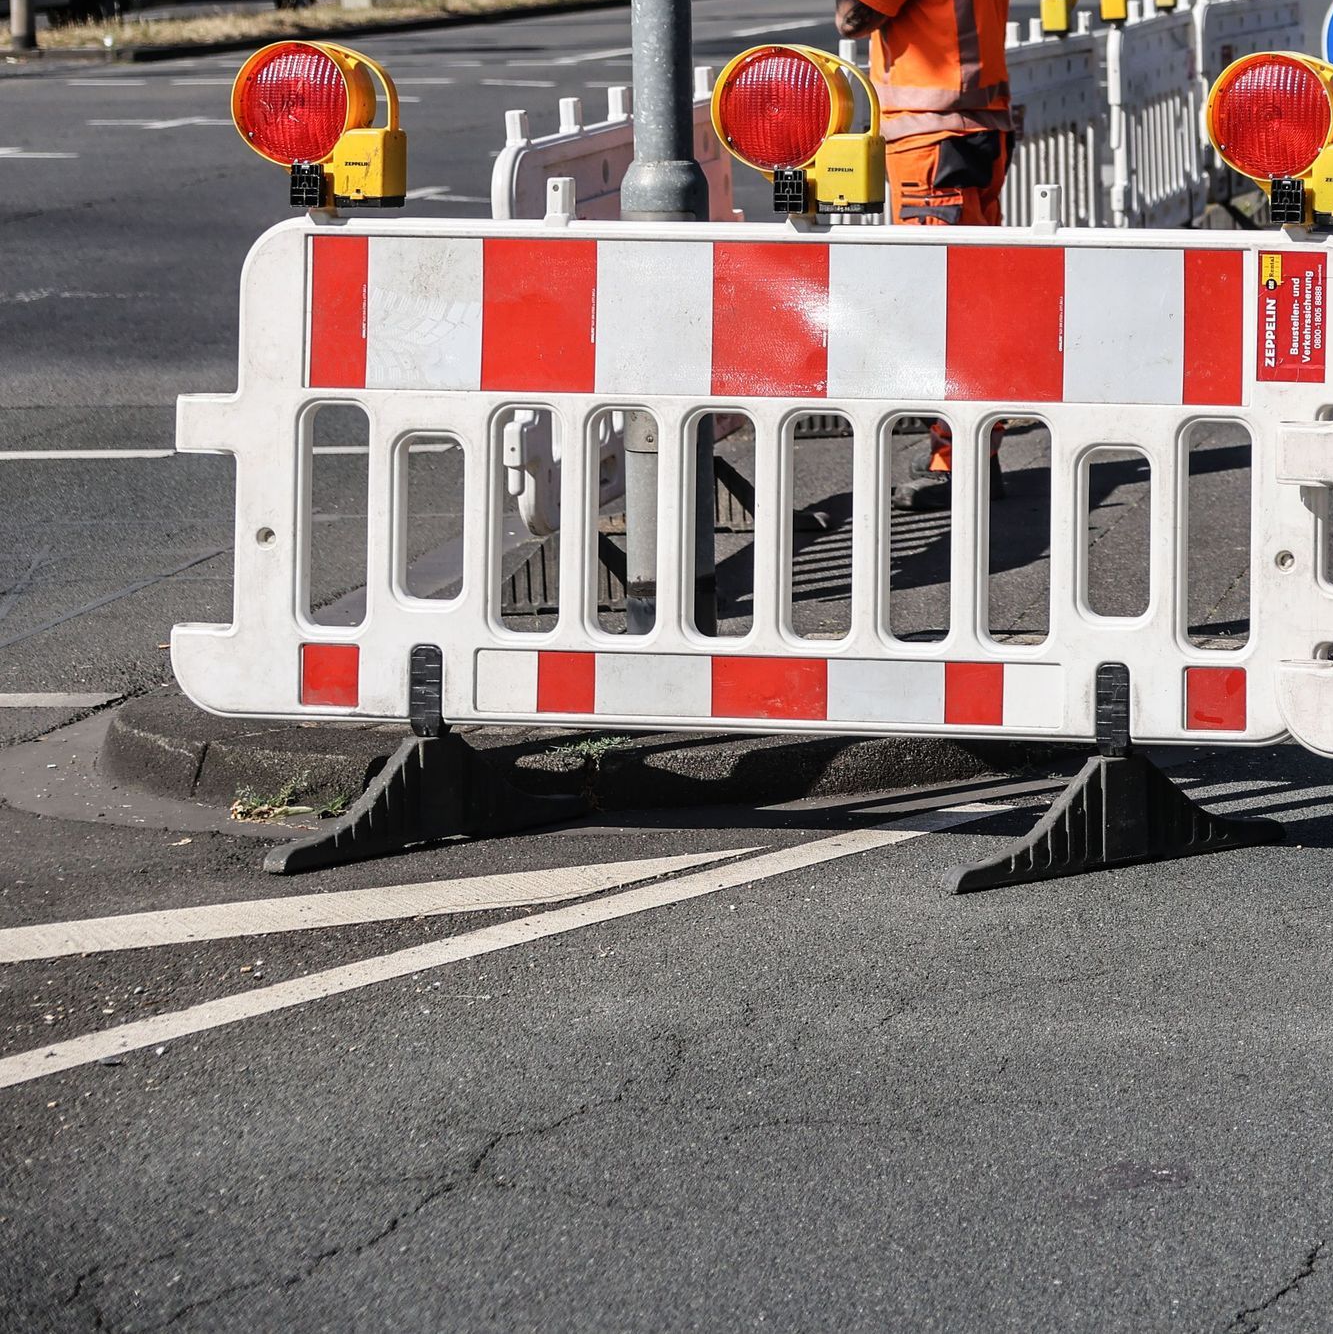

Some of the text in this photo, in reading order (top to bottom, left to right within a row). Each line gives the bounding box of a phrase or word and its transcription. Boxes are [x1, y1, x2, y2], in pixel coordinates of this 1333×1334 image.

[1264, 298, 1277, 368] ZEPPELIN
[1290, 277, 1301, 356] Baustellen- und
[1302, 270, 1314, 363] Verkehrssicherung
[1314, 307, 1322, 349] 0800-1805
